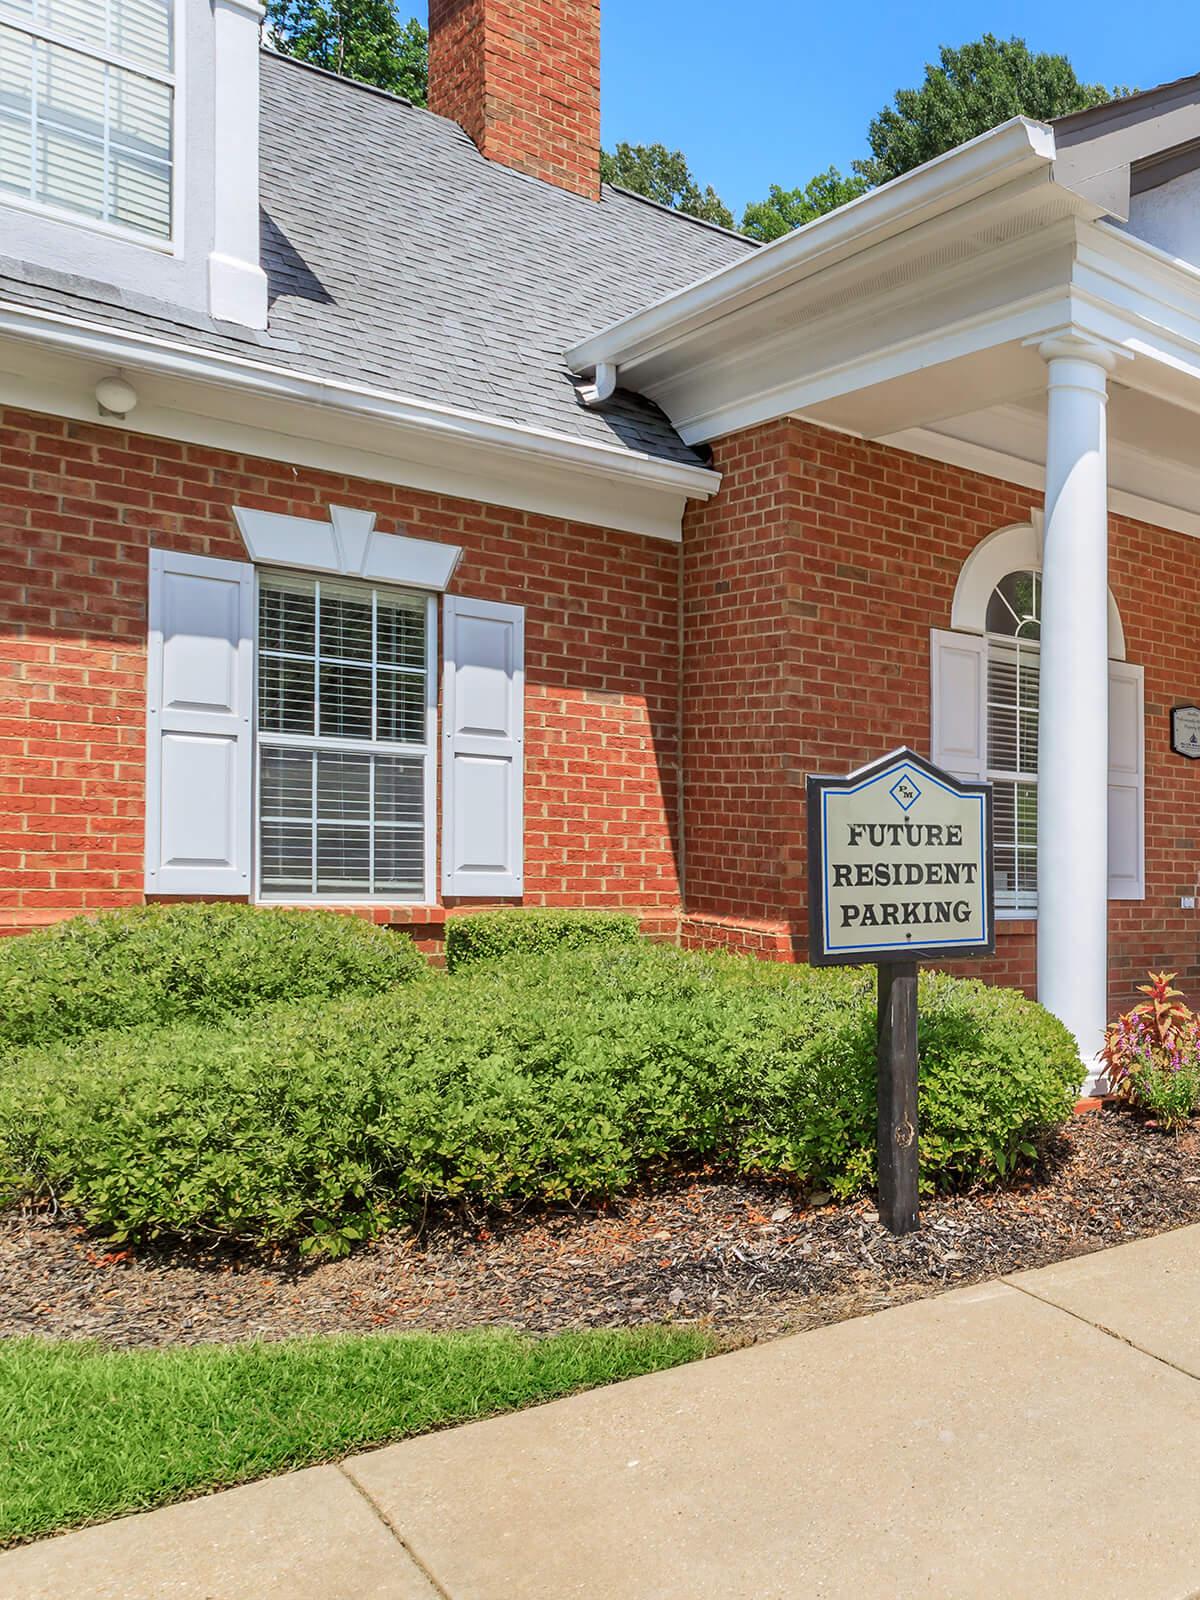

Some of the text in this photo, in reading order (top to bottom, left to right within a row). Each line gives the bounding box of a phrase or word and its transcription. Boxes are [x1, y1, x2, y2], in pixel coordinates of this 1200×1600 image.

[847, 823, 963, 847] FUTURE
[831, 862, 978, 888] RESIDENT
[840, 900, 972, 928] PARKING
